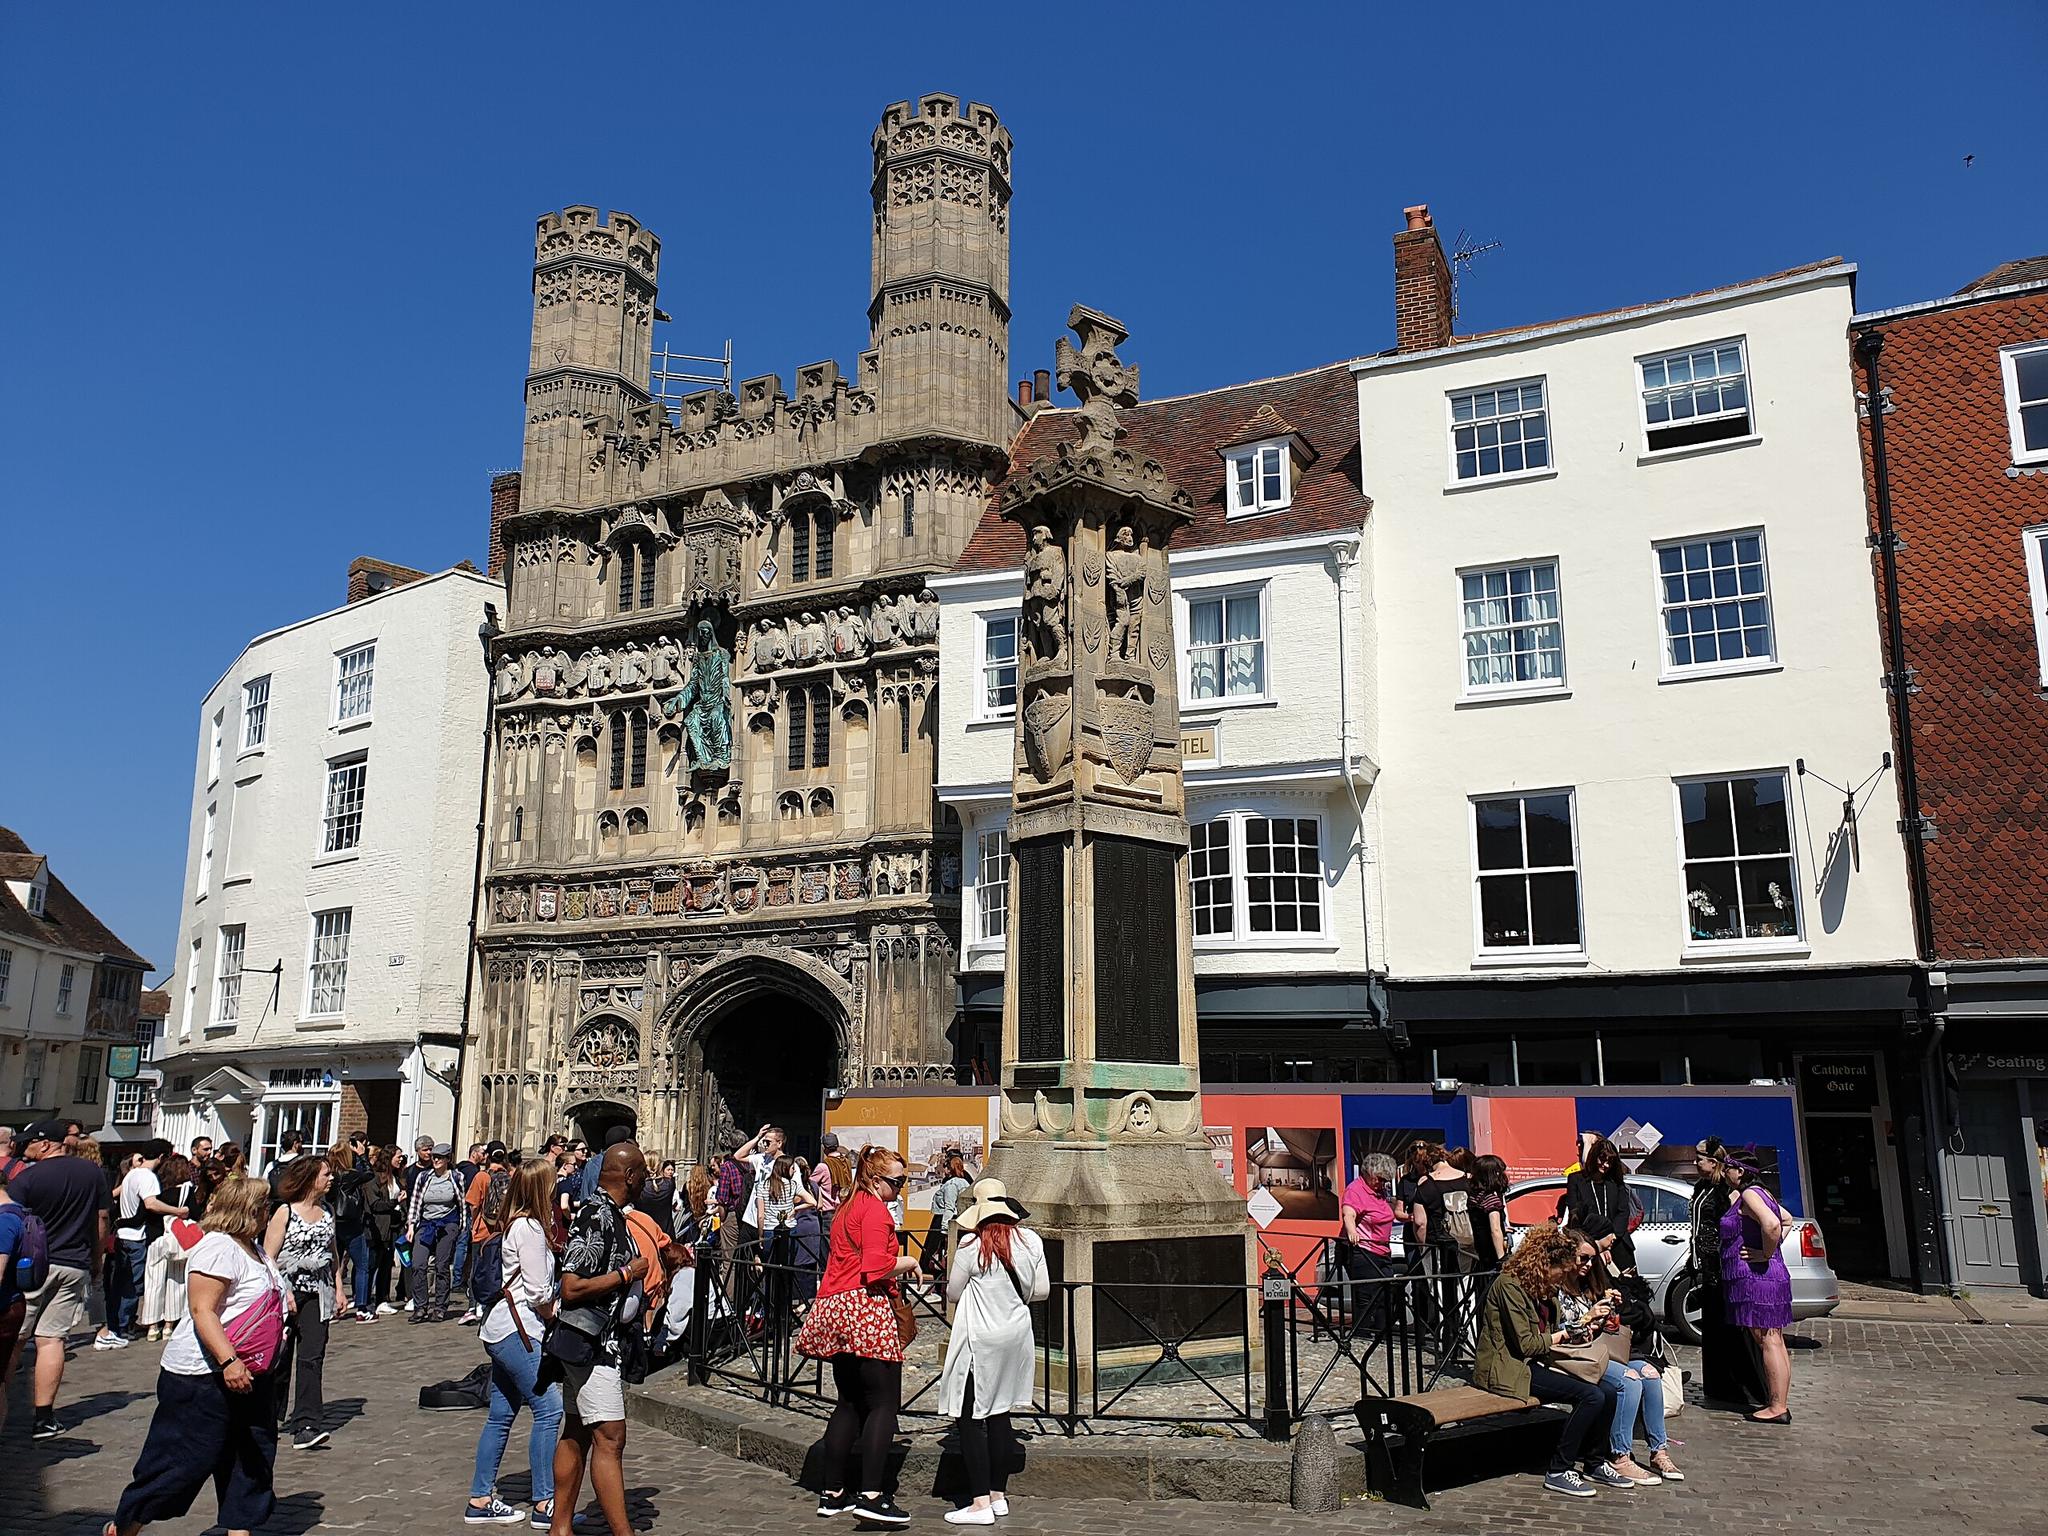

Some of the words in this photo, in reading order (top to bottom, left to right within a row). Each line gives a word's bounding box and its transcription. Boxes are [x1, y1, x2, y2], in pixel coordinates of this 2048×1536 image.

[1182, 737, 1209, 755] TEL
[1811, 1064, 1867, 1076] Cathedral
[1987, 1055, 2046, 1071] Seating
[1826, 1080, 1854, 1091] Gate
